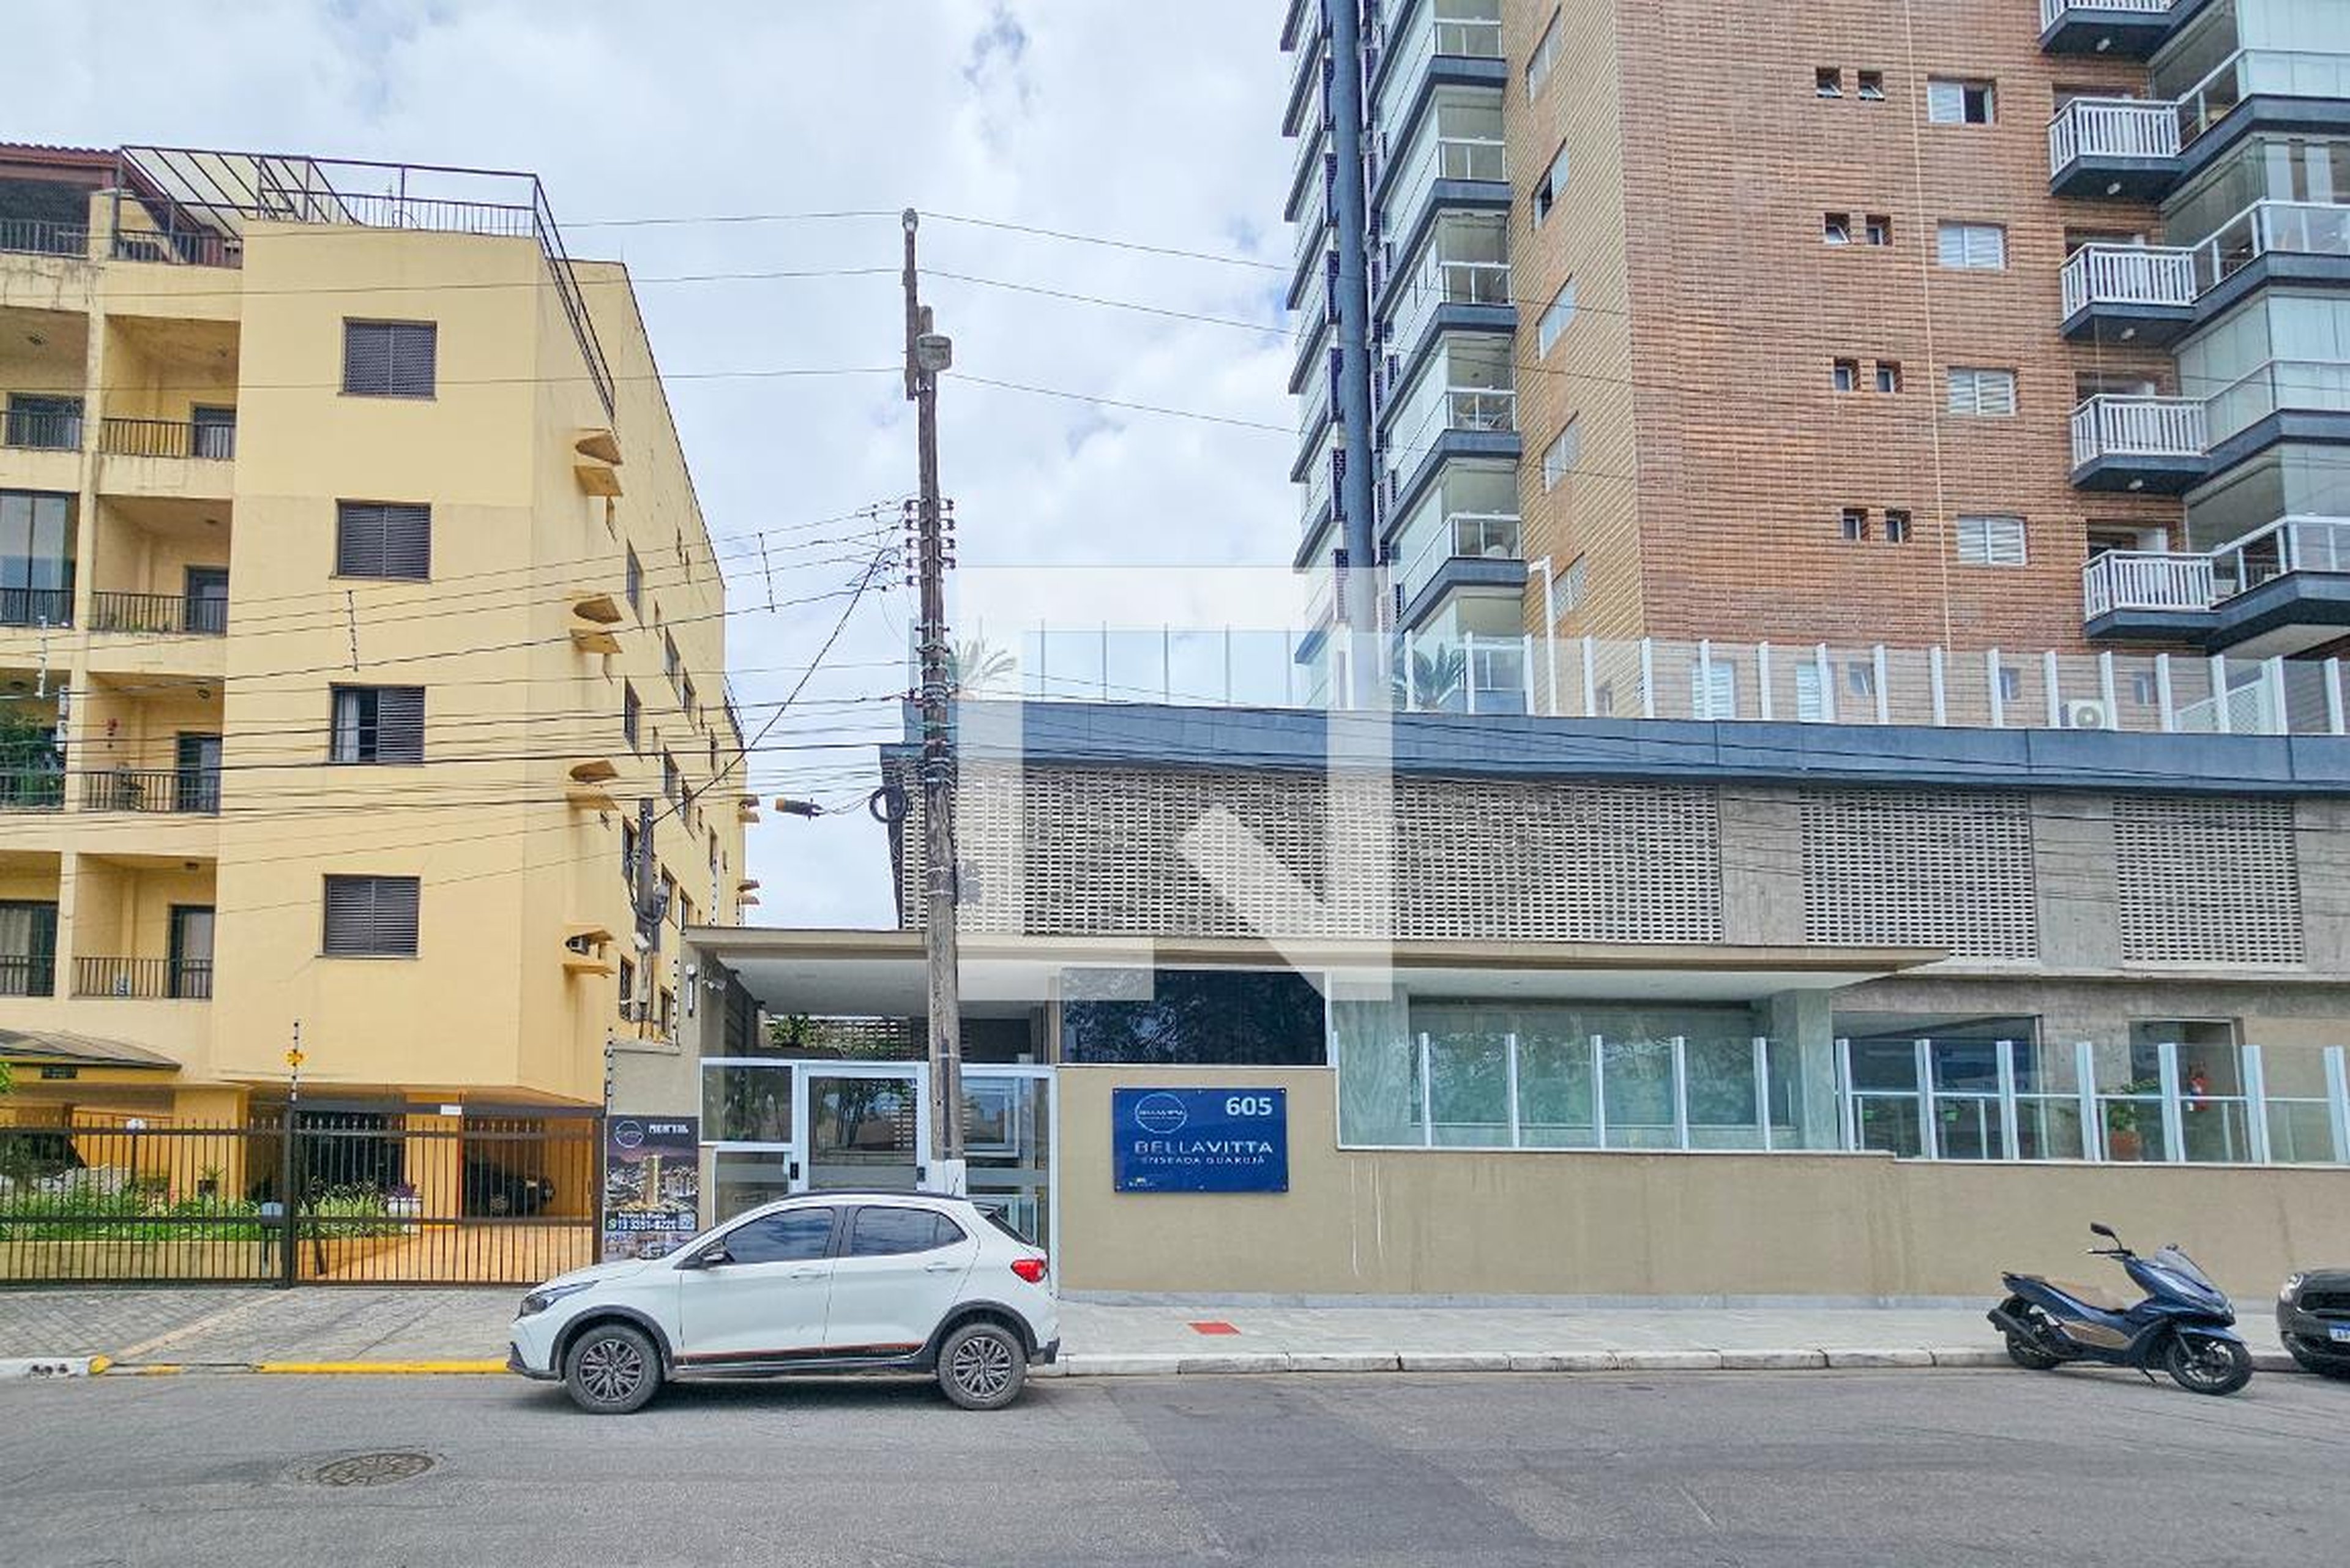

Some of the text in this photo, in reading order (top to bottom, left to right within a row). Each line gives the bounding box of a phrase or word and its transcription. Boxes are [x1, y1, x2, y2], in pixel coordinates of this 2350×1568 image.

[1226, 1097, 1272, 1116] 605
[1134, 1140, 1273, 1154] BELLAVITTA
[1142, 1156, 1200, 1165] ENSEADA
